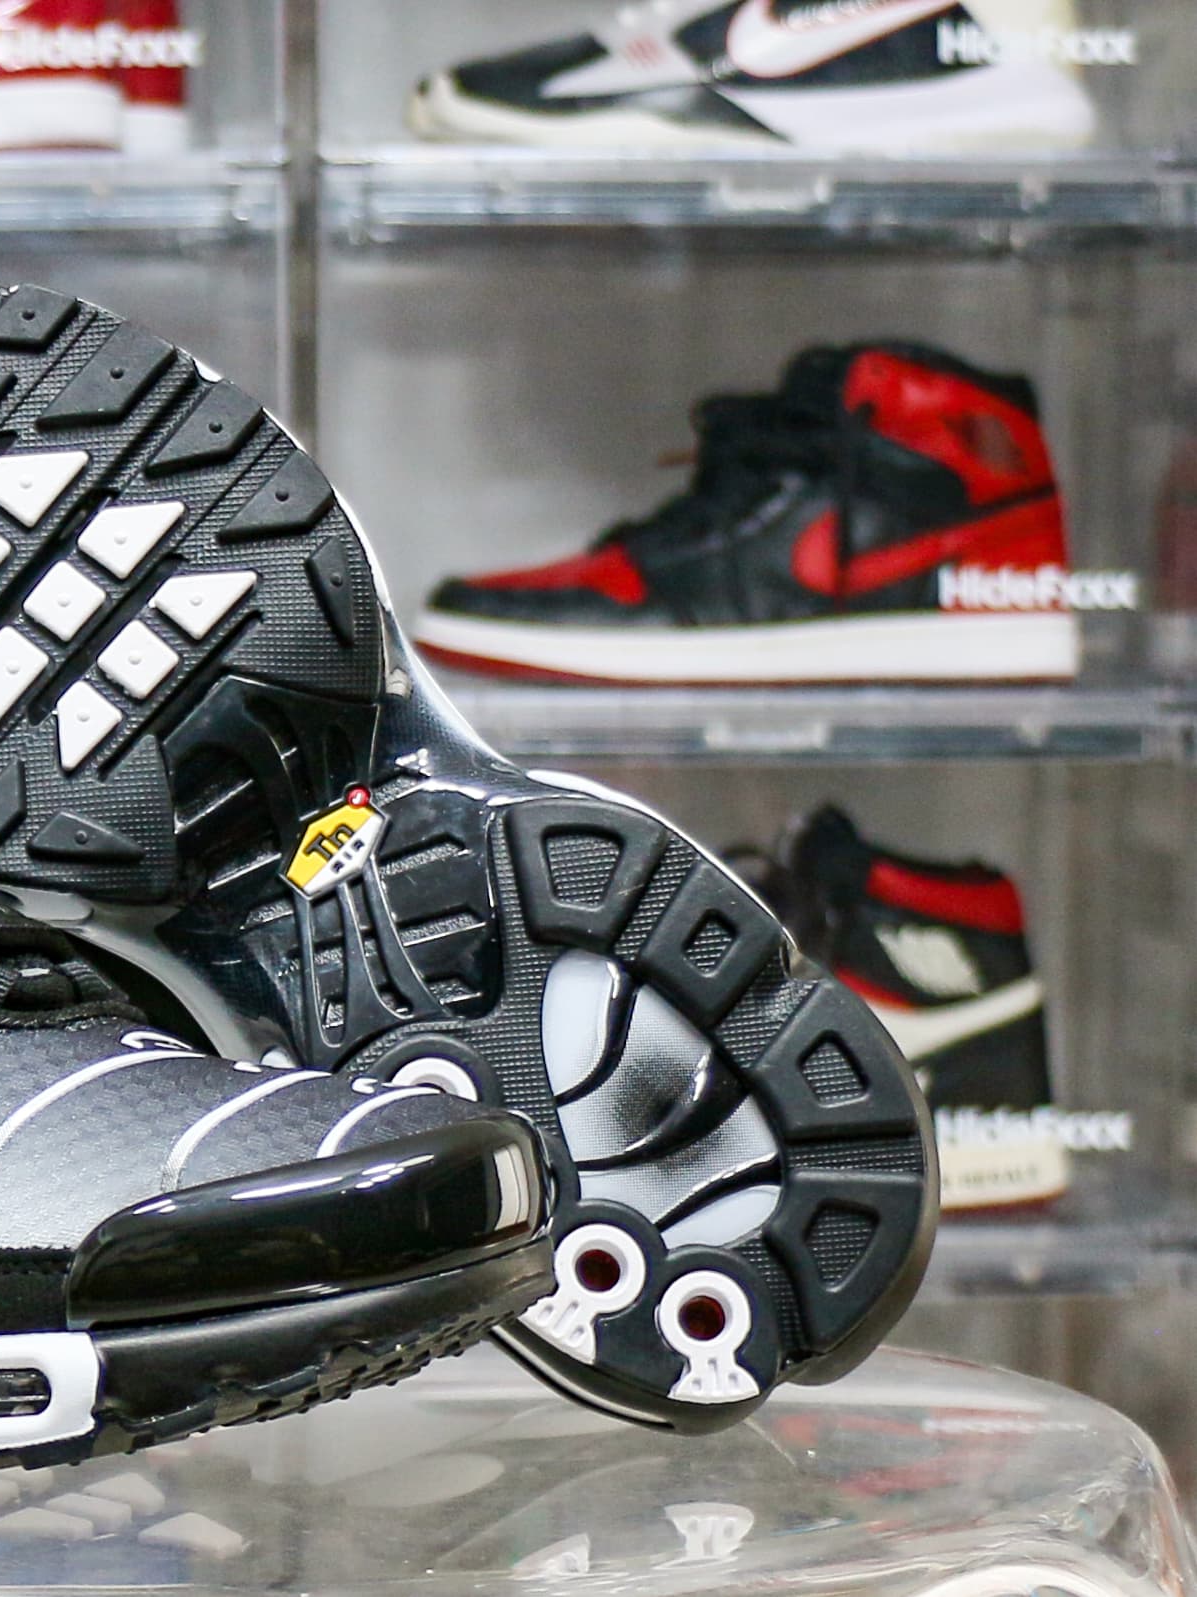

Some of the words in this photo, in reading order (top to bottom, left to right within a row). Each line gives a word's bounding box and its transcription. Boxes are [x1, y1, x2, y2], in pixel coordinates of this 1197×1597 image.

[0, 21, 201, 68] ideFxxx
[936, 20, 1136, 65] HidFxxx
[938, 564, 1136, 610] HideFxxx
[303, 823, 355, 861] Tn
[331, 839, 365, 874] AIR
